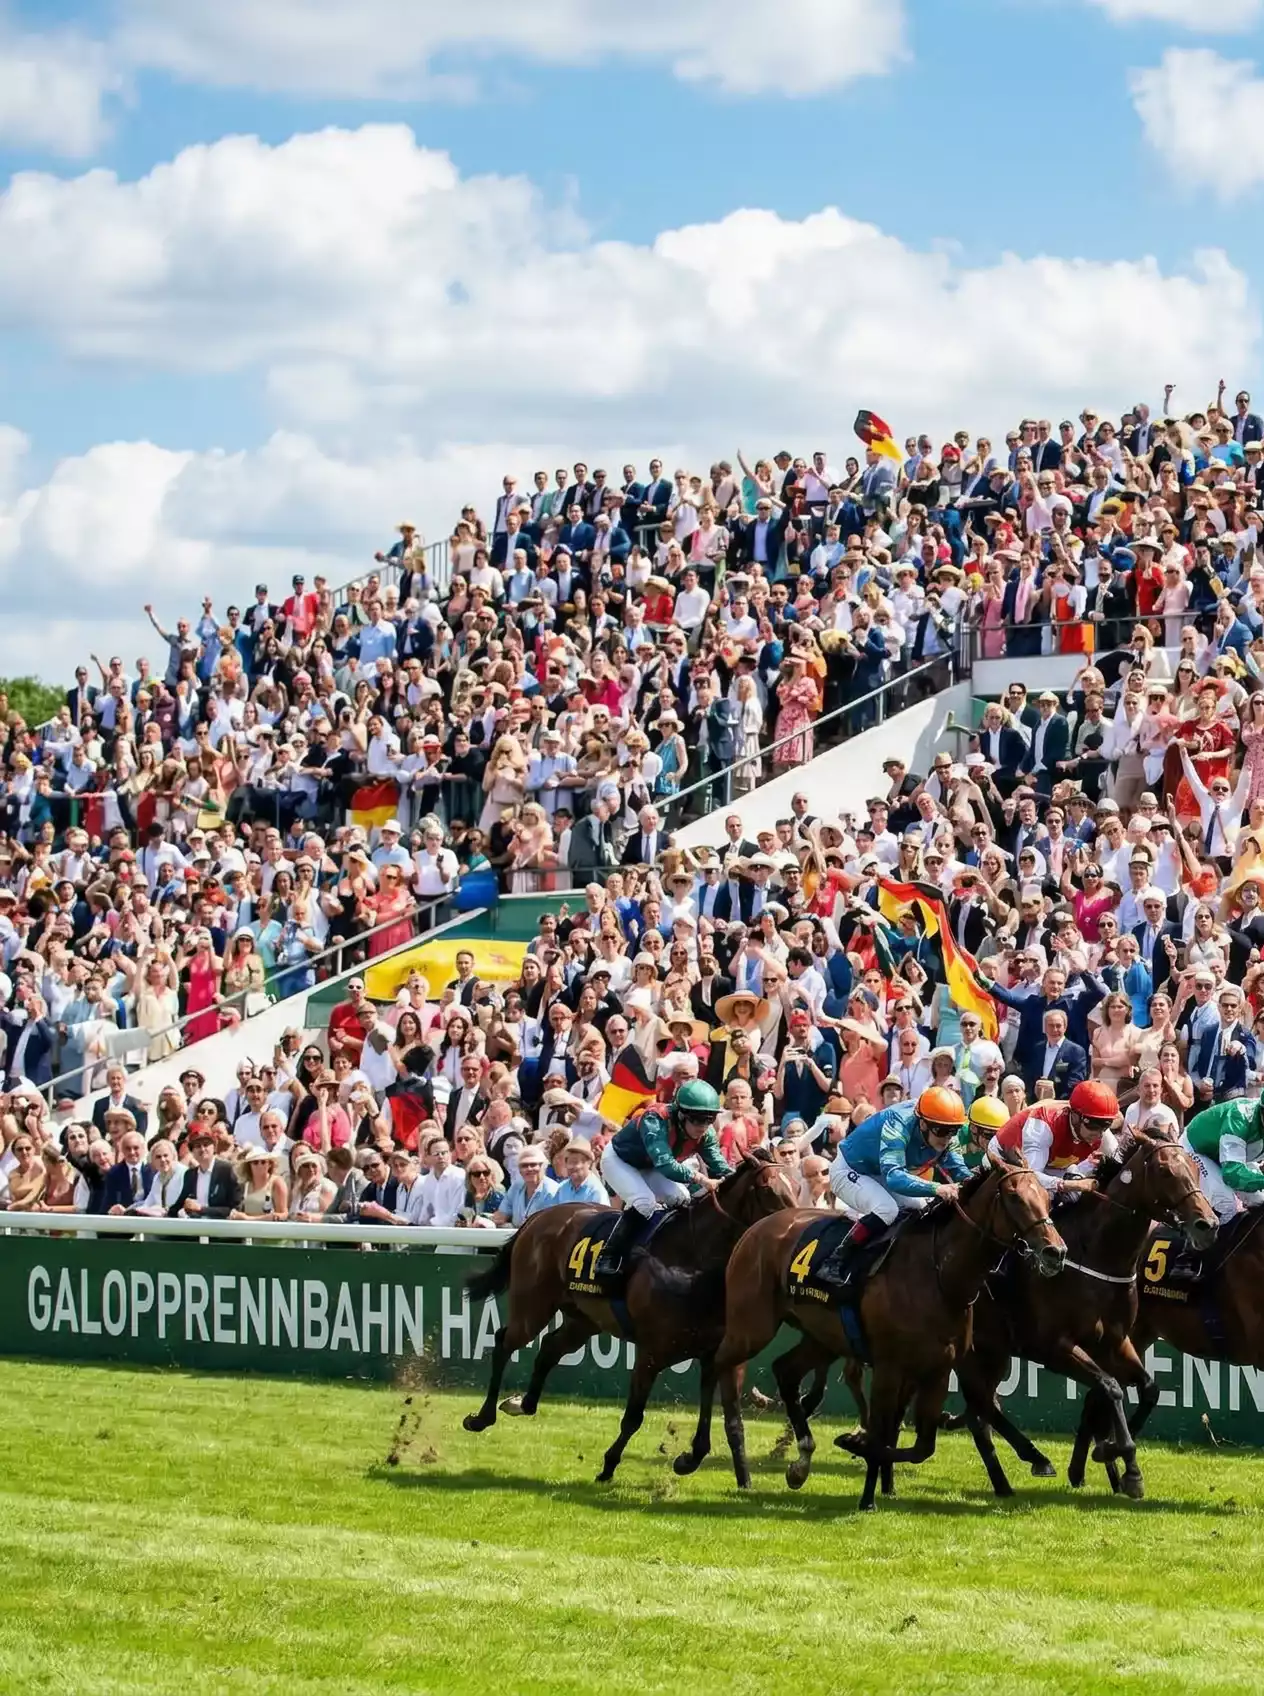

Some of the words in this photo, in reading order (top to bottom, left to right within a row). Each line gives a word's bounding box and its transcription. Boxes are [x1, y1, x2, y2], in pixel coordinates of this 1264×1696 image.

[790, 1239, 819, 1283] 4
[1144, 1240, 1172, 1282] 5
[27, 1265, 424, 1356] GALOPPRENNBAHN
